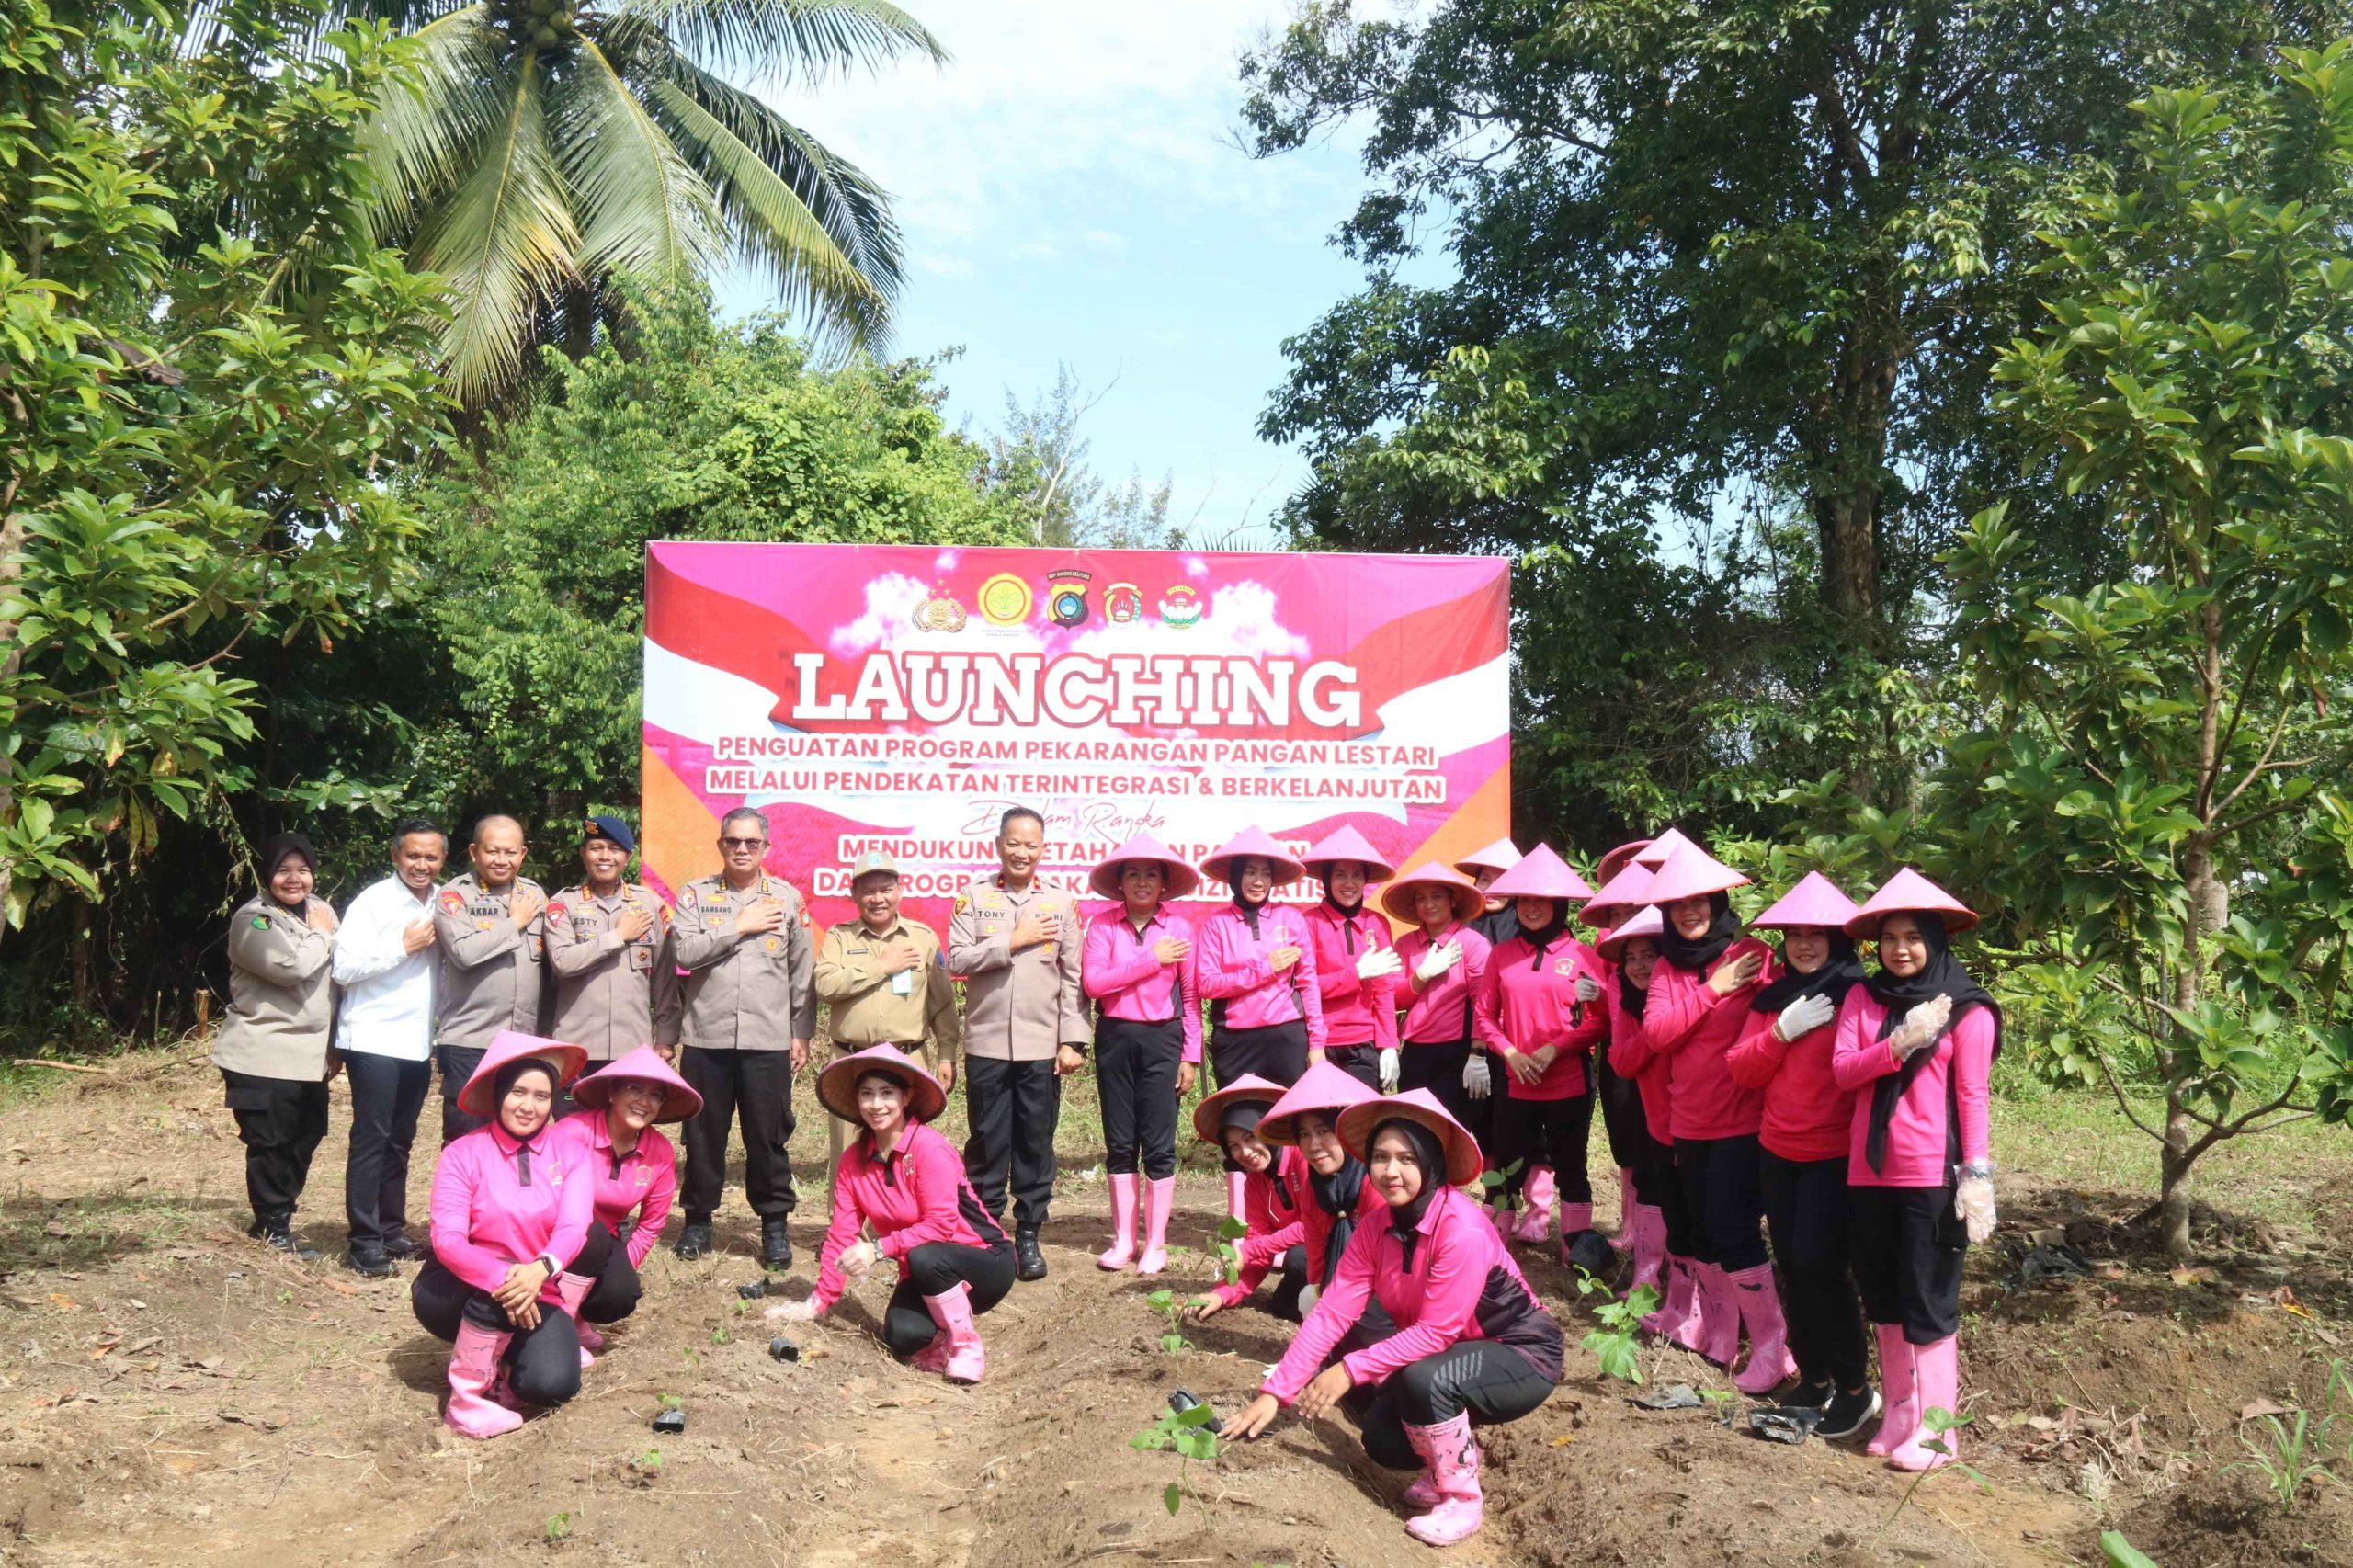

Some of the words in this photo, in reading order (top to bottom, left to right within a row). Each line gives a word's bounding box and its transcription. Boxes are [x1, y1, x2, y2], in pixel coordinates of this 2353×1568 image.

[792, 652, 1362, 728] LAUNCHING
[718, 736, 879, 757] PENGUATAN
[885, 738, 1018, 759] PROGRAM
[1025, 740, 1208, 762] PEKARANGAN
[1214, 743, 1327, 765] PANGAN
[1334, 744, 1435, 766] LESTARI
[710, 769, 818, 790] MELALUI
[824, 771, 1000, 792] PENDEKATAN
[1006, 774, 1189, 795] TERINTEGRASI
[1198, 776, 1214, 796] &
[1222, 777, 1442, 799] BERKELANJUTAN
[960, 798, 1071, 835] Dlam
[1082, 798, 1165, 845] Rangka
[842, 838, 999, 860] MENDUKUN
[1040, 840, 1186, 862] ETAHN
[818, 872, 854, 892] DA
[1272, 878, 1325, 898] ATIS
[470, 907, 499, 916] AKBAR
[574, 917, 597, 926] ESTY
[700, 905, 733, 914] BAMBANG
[977, 910, 1006, 918] TONY
[1034, 913, 1063, 922] PRI
